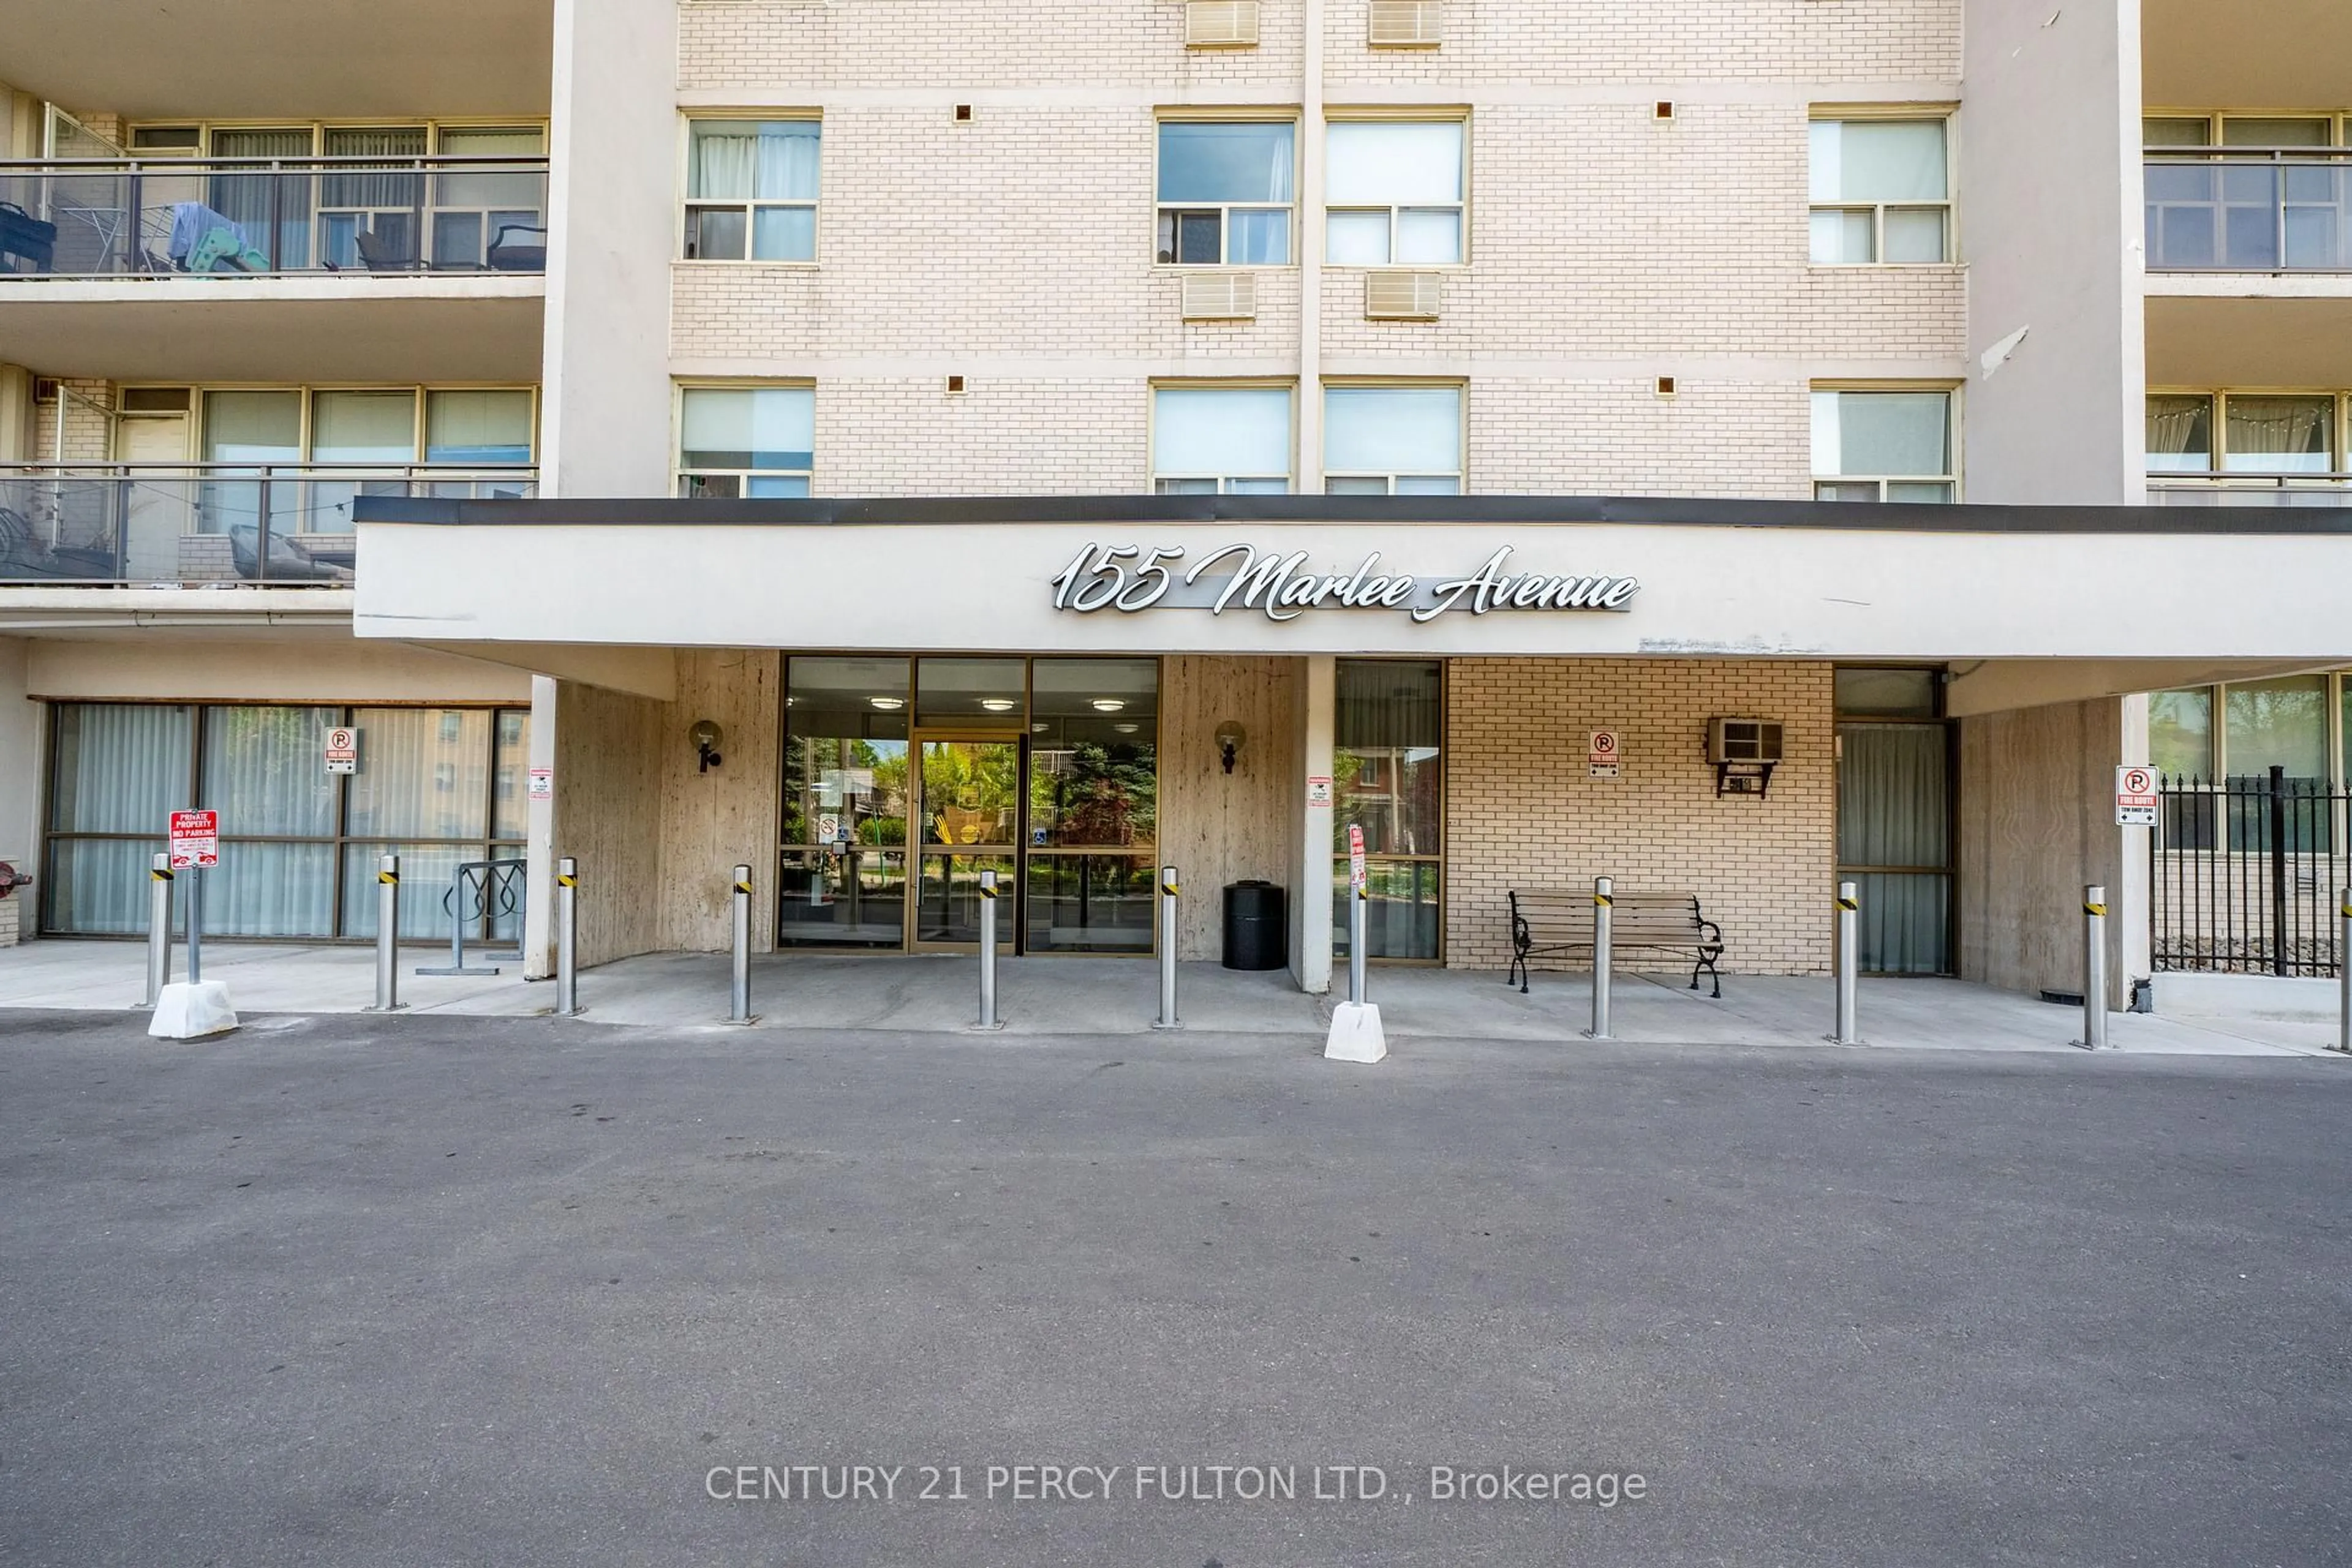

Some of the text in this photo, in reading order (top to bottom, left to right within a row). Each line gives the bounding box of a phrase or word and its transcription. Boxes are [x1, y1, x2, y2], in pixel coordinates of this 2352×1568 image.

[1050, 542, 1641, 624] 155 Marlee Avenue
[2134, 796, 2154, 805] ROUTE
